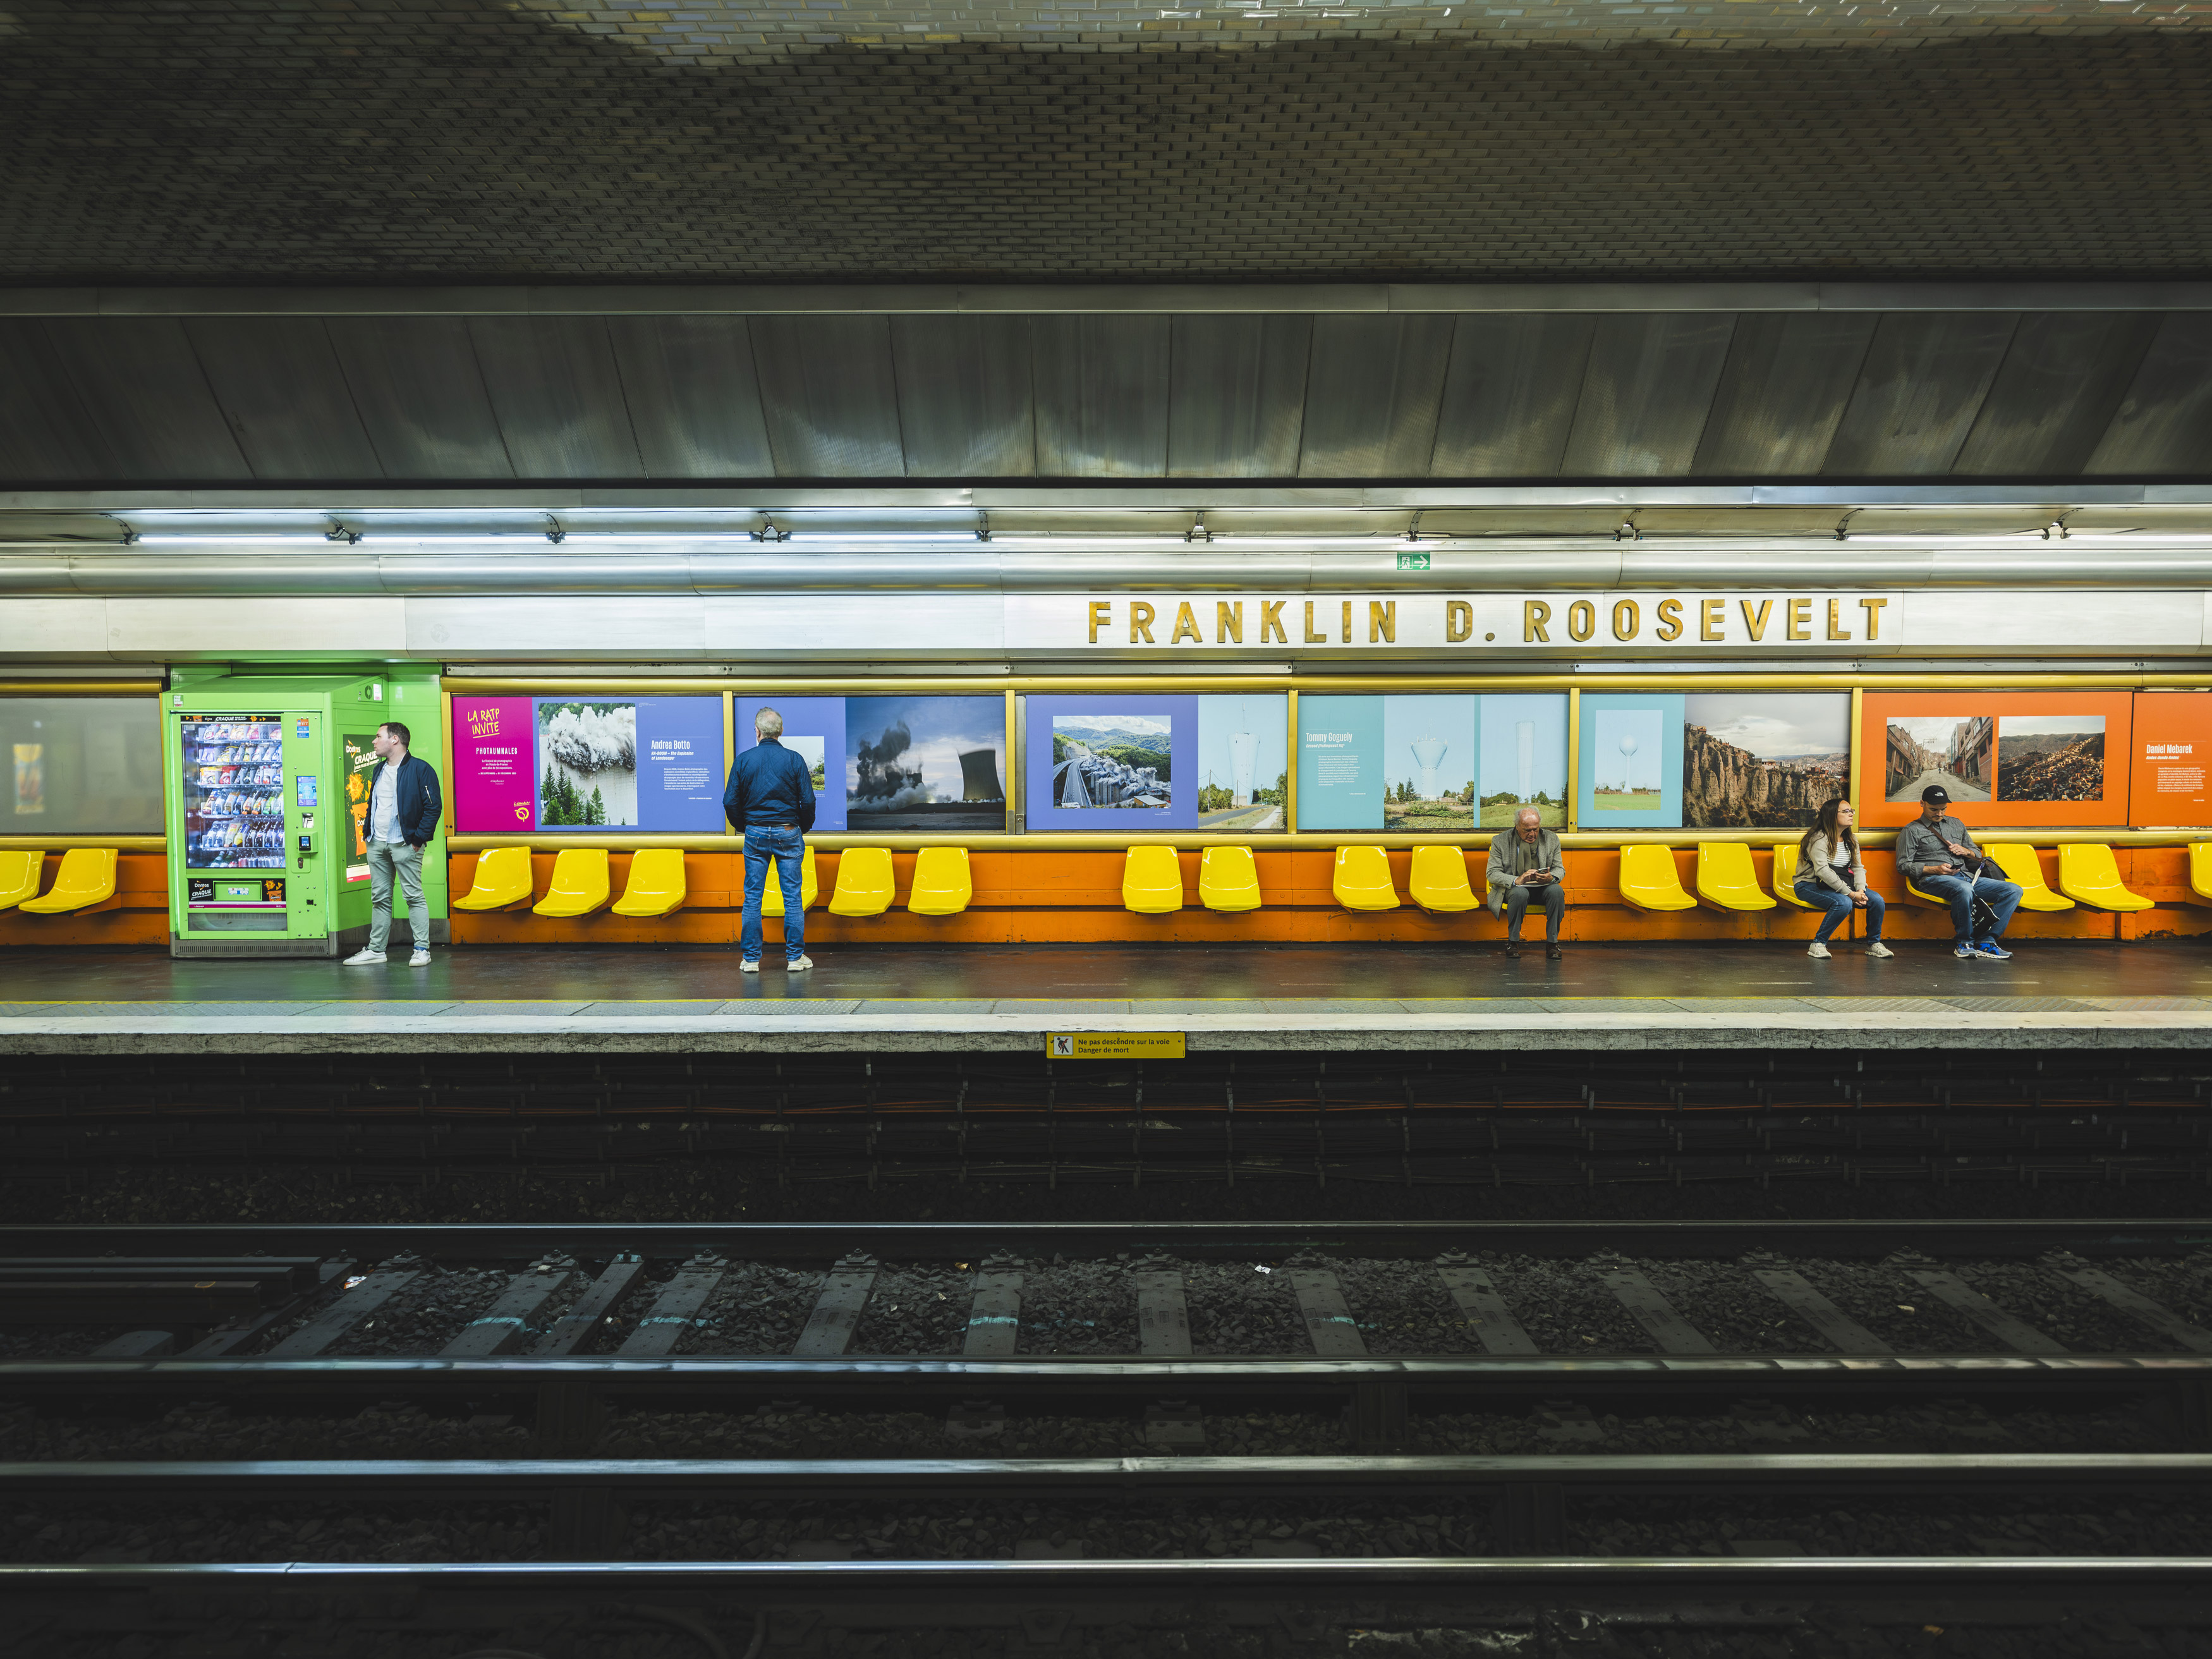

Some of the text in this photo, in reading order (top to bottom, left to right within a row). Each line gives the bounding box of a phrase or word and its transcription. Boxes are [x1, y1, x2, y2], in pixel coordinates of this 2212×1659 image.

[1090, 599, 1887, 643] FRANKLIN D. ROOSEVELT
[467, 708, 500, 722] LA RATP
[472, 721, 499, 735] INVITE
[1306, 732, 1352, 743] Tommy Goguely
[346, 745, 361, 753] Doritos
[651, 740, 690, 750] Andrea Botto
[2146, 744, 2192, 753] Daniel Mebarek
[355, 750, 378, 765] CRAQUE
